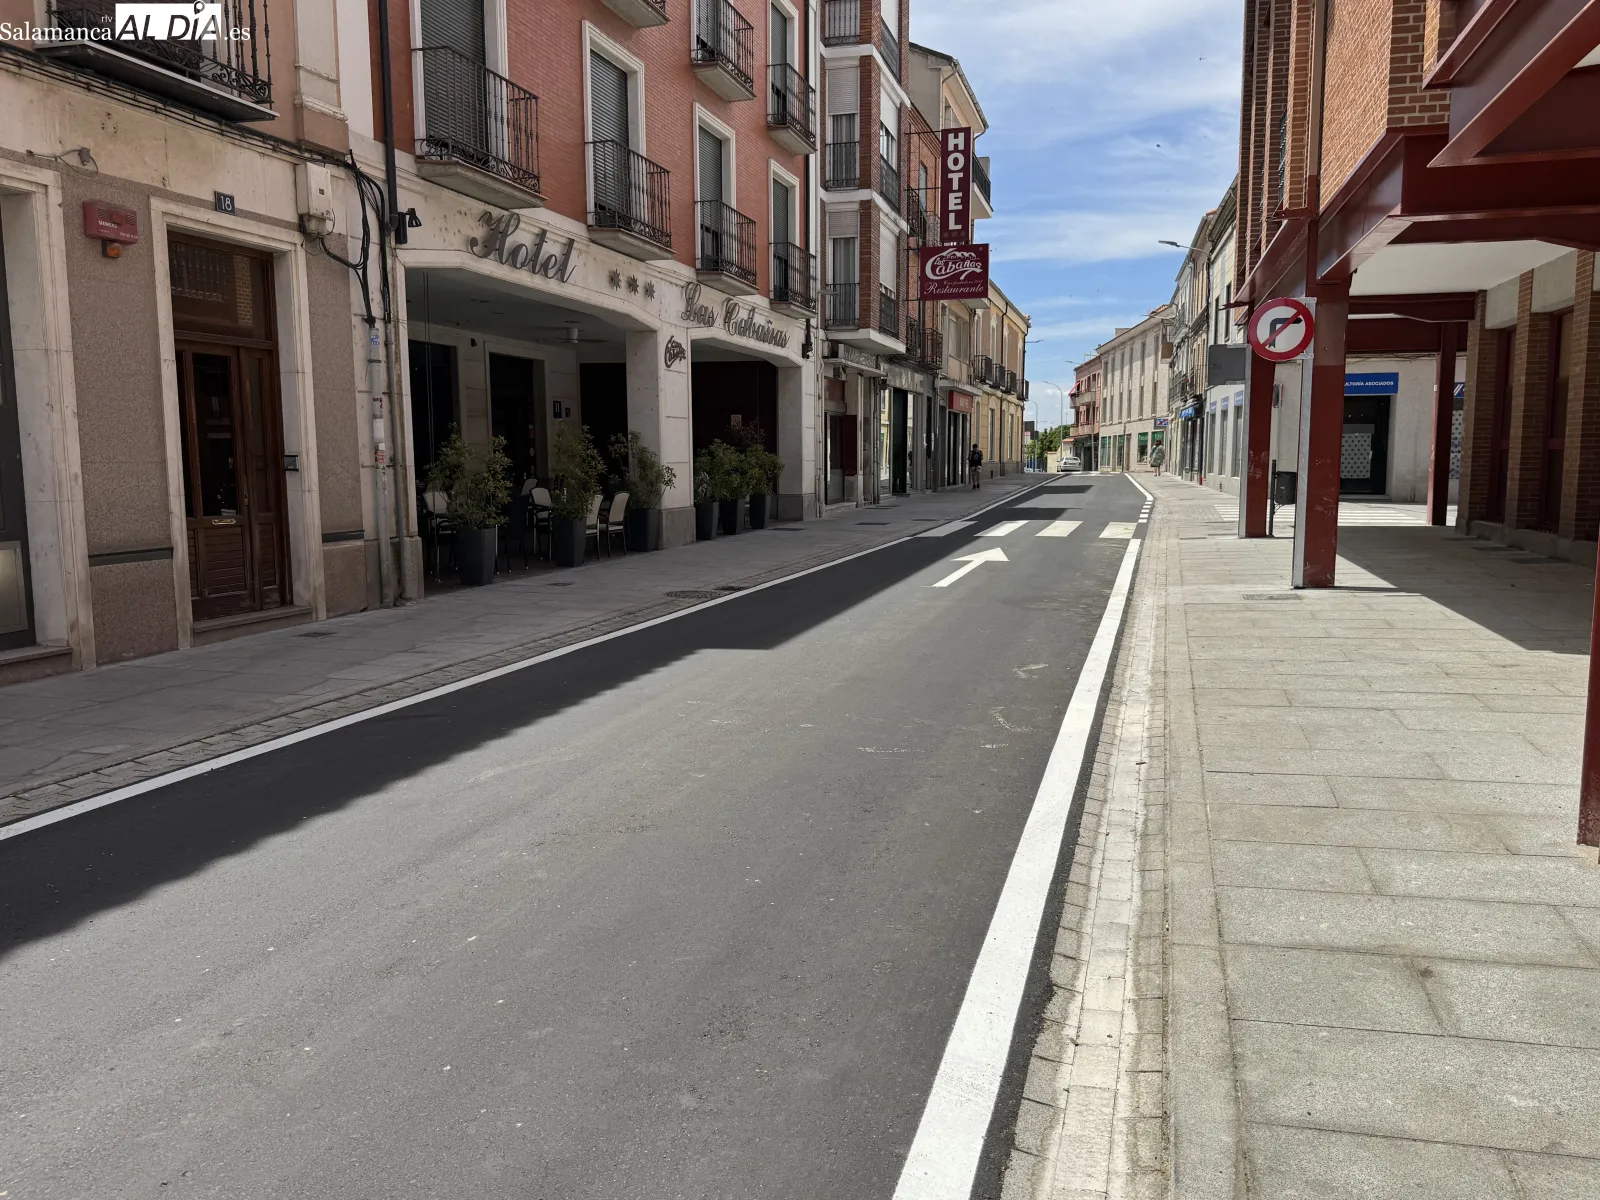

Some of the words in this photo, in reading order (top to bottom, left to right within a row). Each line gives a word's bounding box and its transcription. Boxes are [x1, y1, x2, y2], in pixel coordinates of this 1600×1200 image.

[220, 196, 232, 211] 18
[947, 132, 965, 230] HOTEL
[470, 211, 577, 283] Hotel
[925, 248, 983, 280] Cabañas
[924, 282, 984, 294] Restaurante
[681, 281, 719, 327] Las
[723, 297, 790, 348] Cabañas
